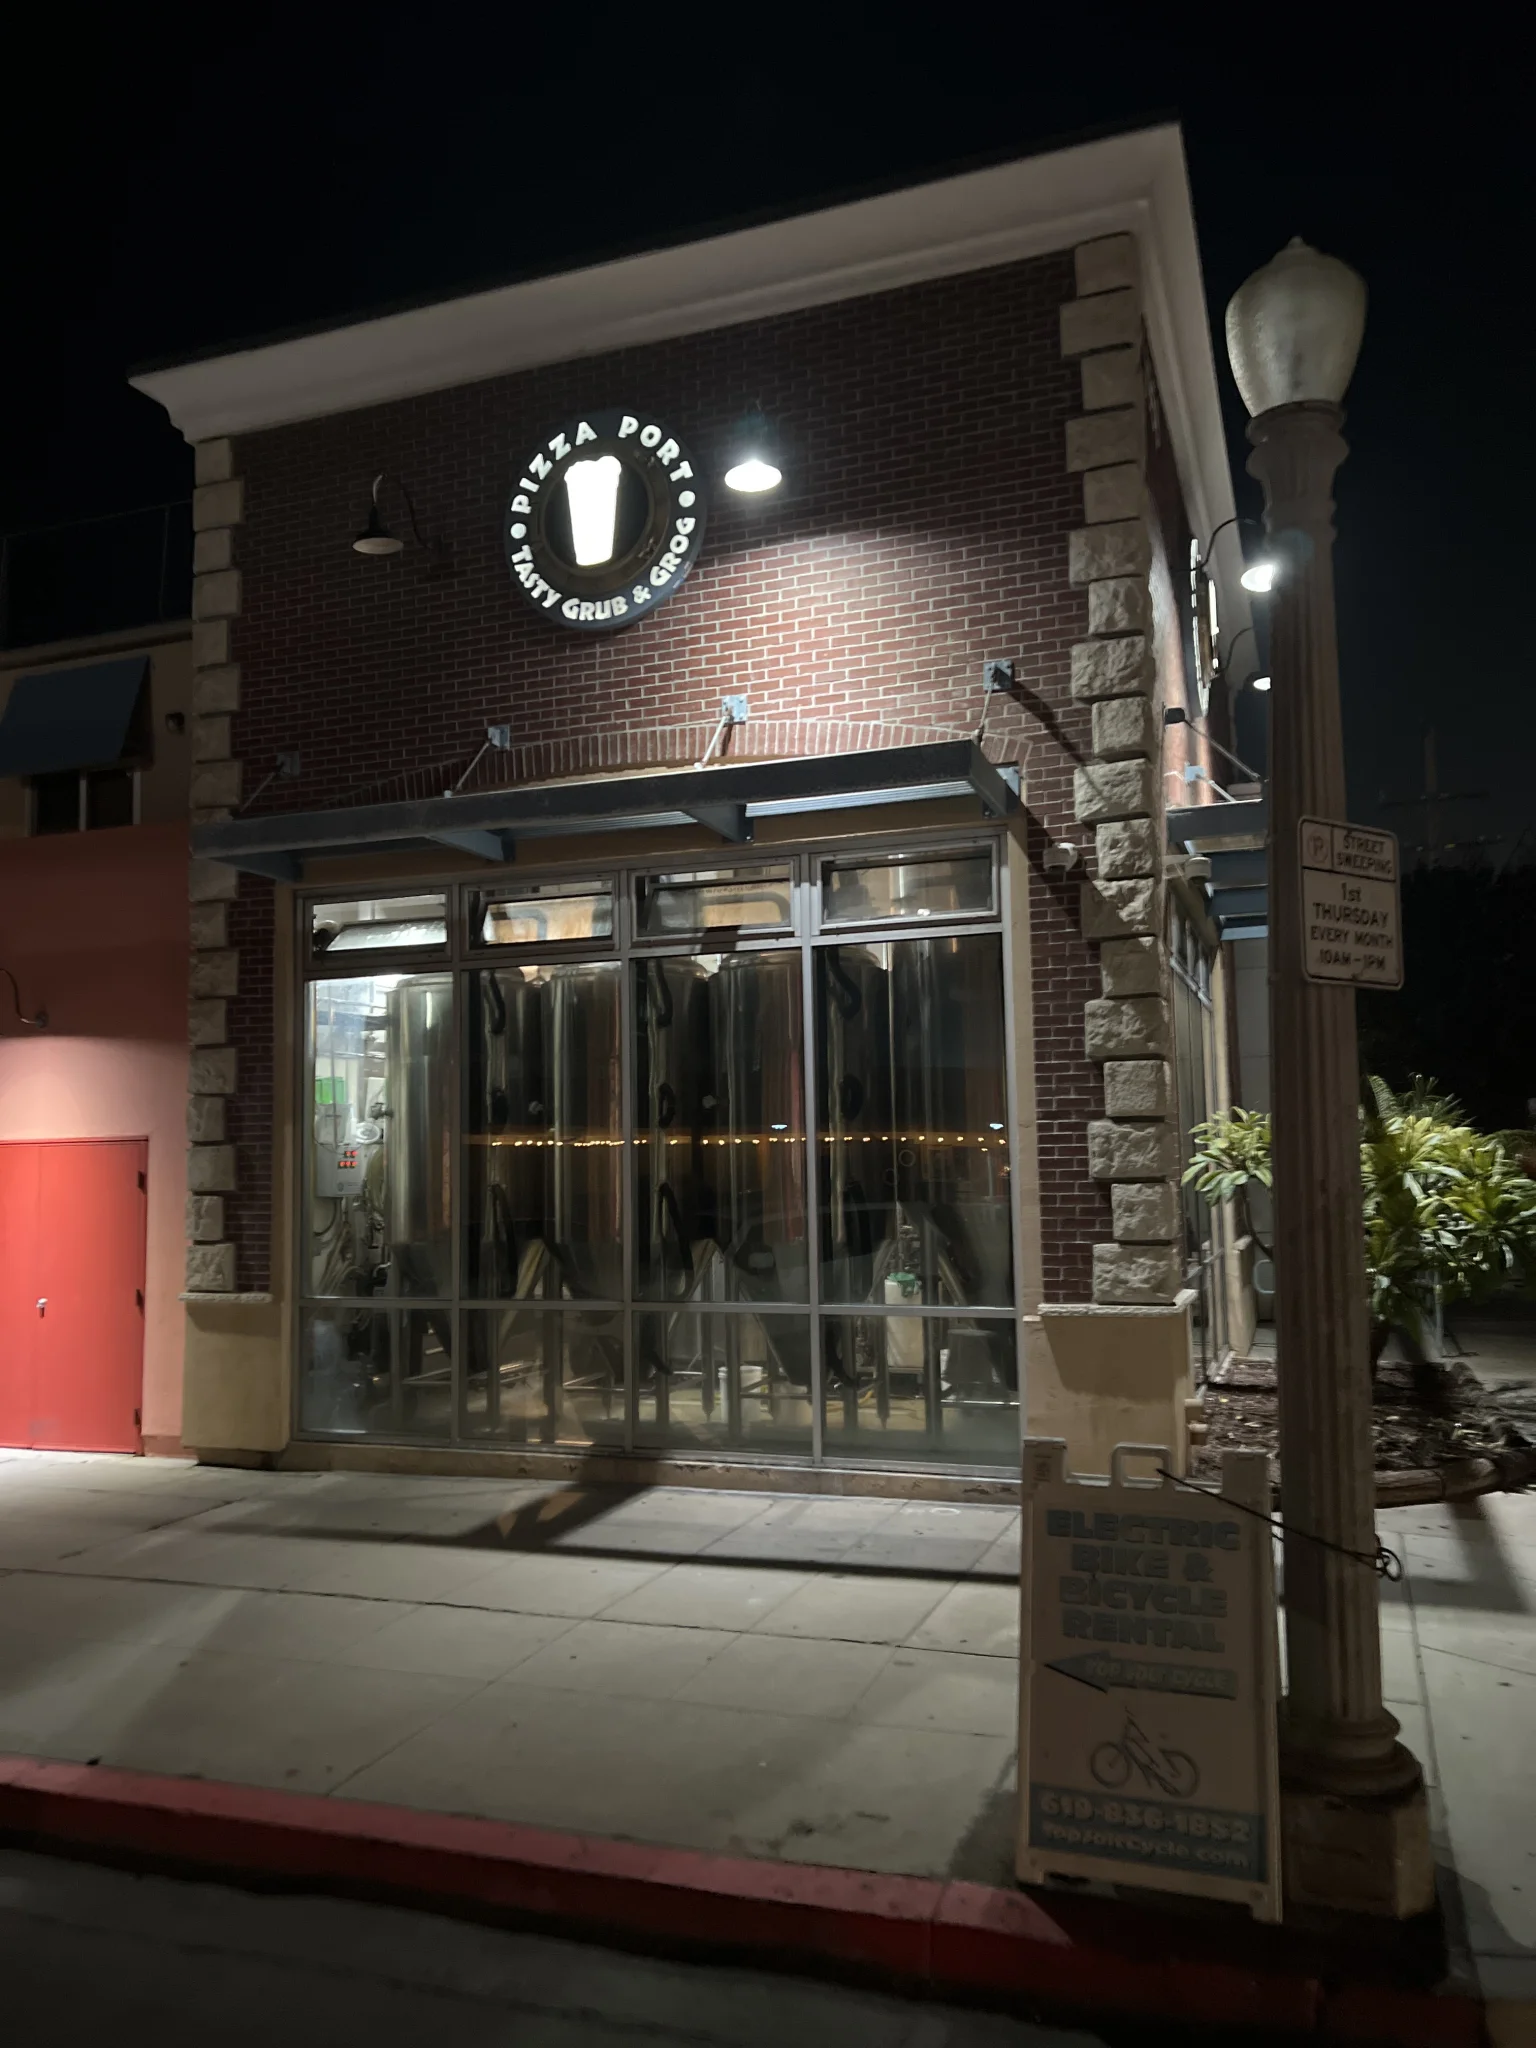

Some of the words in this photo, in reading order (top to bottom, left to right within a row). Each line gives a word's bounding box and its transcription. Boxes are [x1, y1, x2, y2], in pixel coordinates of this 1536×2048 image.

[511, 421, 598, 514] PIZZA
[618, 416, 693, 482] PORT
[511, 545, 562, 608] TASTY
[562, 596, 628, 621] GRUB
[632, 585, 651, 604] &
[650, 517, 696, 586] GROG
[1336, 852, 1392, 874] SWEEPING
[1343, 834, 1385, 854] STREET
[1341, 882, 1362, 902] 1st
[1312, 902, 1389, 928] THURSDAY
[1310, 925, 1350, 944] EVERY
[1354, 931, 1394, 949] MONTH
[1046, 1509, 1241, 1551] ELECTRIC
[1071, 1543, 1170, 1578] BIKE
[1182, 1552, 1214, 1583] &
[1059, 1575, 1228, 1618] BICYCLE
[1061, 1608, 1226, 1653] RENTAL
